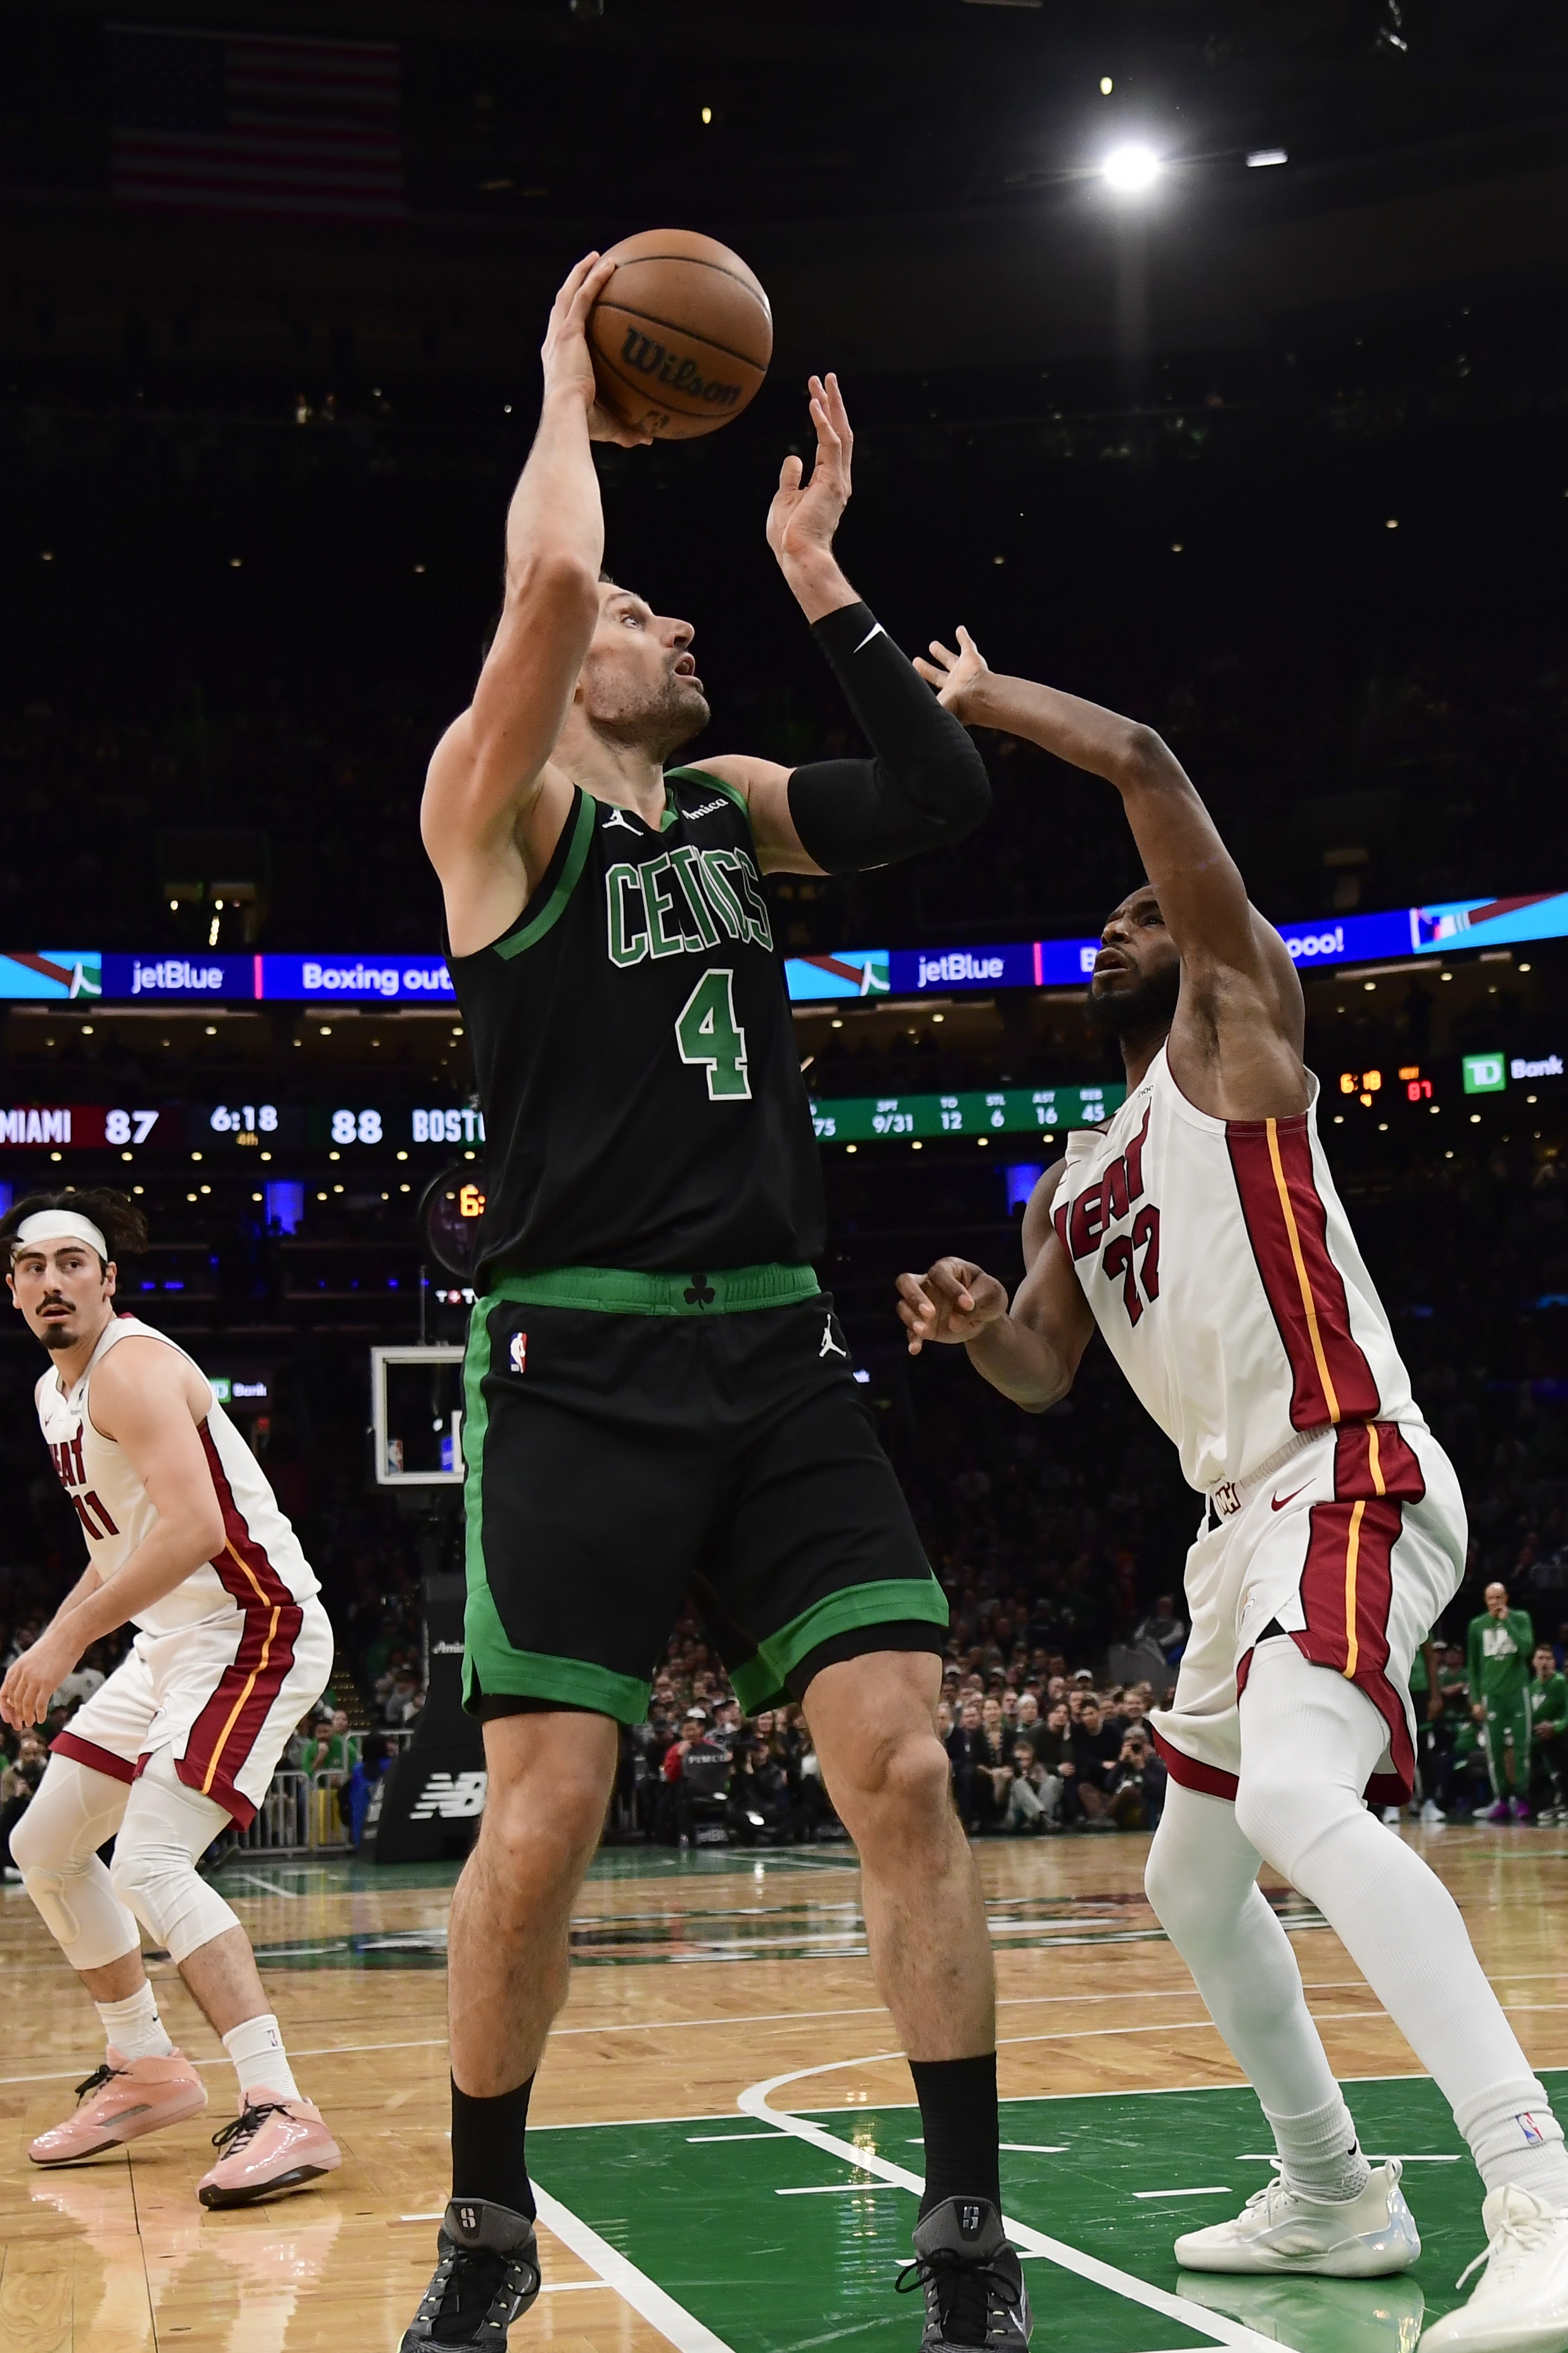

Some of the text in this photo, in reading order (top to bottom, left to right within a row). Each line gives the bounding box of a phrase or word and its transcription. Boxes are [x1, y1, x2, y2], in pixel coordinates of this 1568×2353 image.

[621, 325, 743, 407] Wilson
[681, 798, 729, 820] Amica
[131, 959, 224, 995] jetBlue
[302, 962, 399, 996] Boxing
[917, 952, 1005, 988] jetBlue
[675, 969, 752, 1100] 4
[1467, 1054, 1564, 1086] TD Bank
[0, 1109, 72, 1144] MIAMI
[105, 1109, 160, 1145] 87
[210, 1104, 278, 1131] 6:18
[331, 1109, 383, 1144] 88
[872, 1114, 913, 1133] 9/31
[941, 1111, 963, 1130] 12
[991, 1109, 1005, 1127] 6
[1036, 1106, 1058, 1125] 16
[1081, 1103, 1105, 1121] 45
[233, 1381, 267, 1397] Bank
[73, 1490, 120, 1540] 11
[409, 1771, 488, 1820] NB
